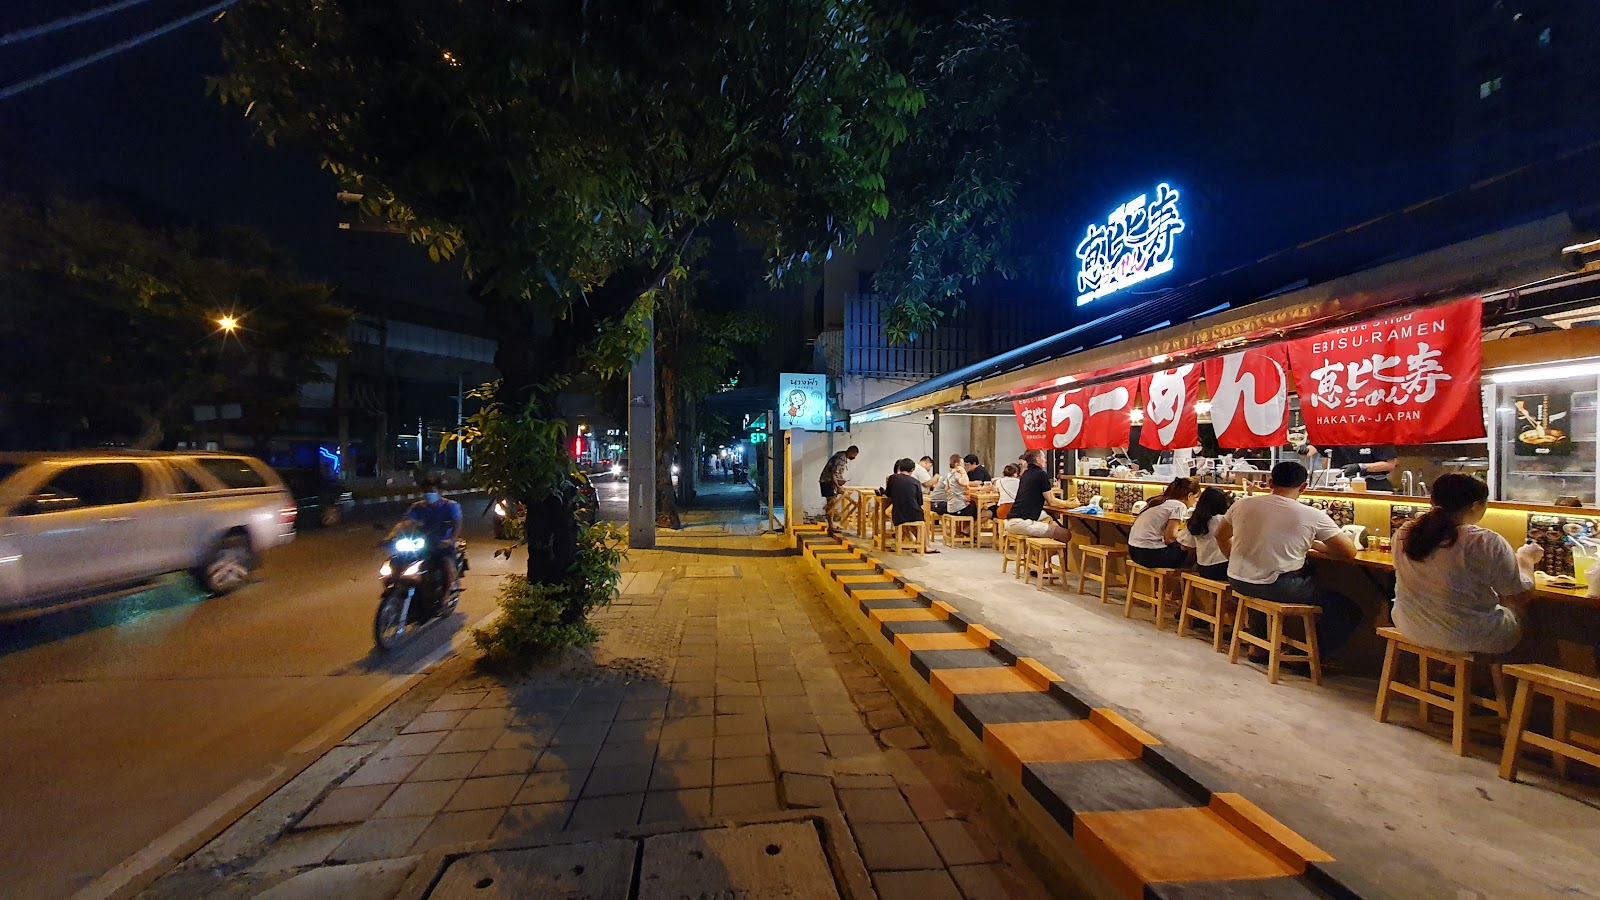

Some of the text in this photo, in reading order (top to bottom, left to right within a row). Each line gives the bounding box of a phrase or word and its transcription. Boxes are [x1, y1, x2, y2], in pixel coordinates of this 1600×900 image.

[1312, 319, 1446, 354] EBISU-RAMEN
[1310, 342, 1452, 409] 恵比寿
[1316, 410, 1421, 425] HAKATA-JAPAN
